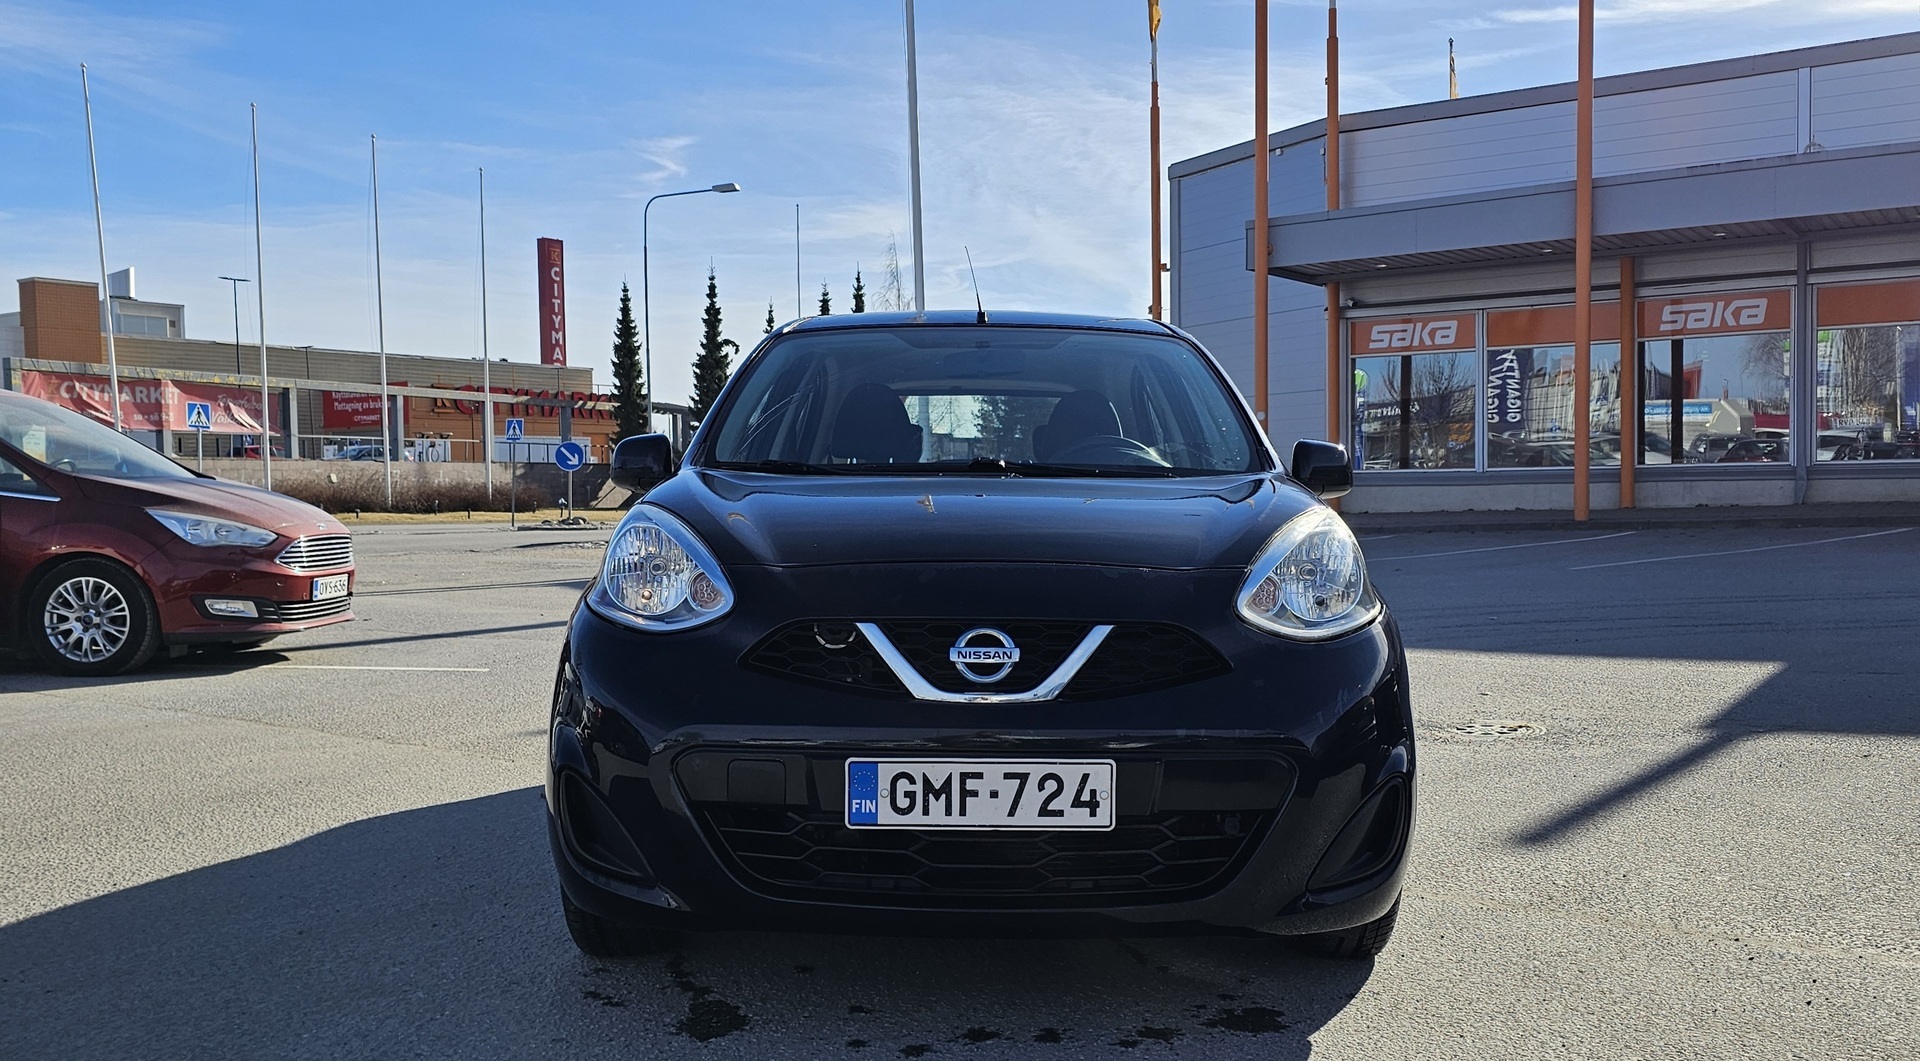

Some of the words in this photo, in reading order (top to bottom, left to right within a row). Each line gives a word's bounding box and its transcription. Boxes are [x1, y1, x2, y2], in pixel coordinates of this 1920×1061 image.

[456, 385, 614, 420] CITYMARK
[320, 580, 346, 595] OVS-636
[957, 651, 1012, 660] NISSAN
[852, 800, 876, 813] FIN
[889, 771, 1100, 817] GMF-724
